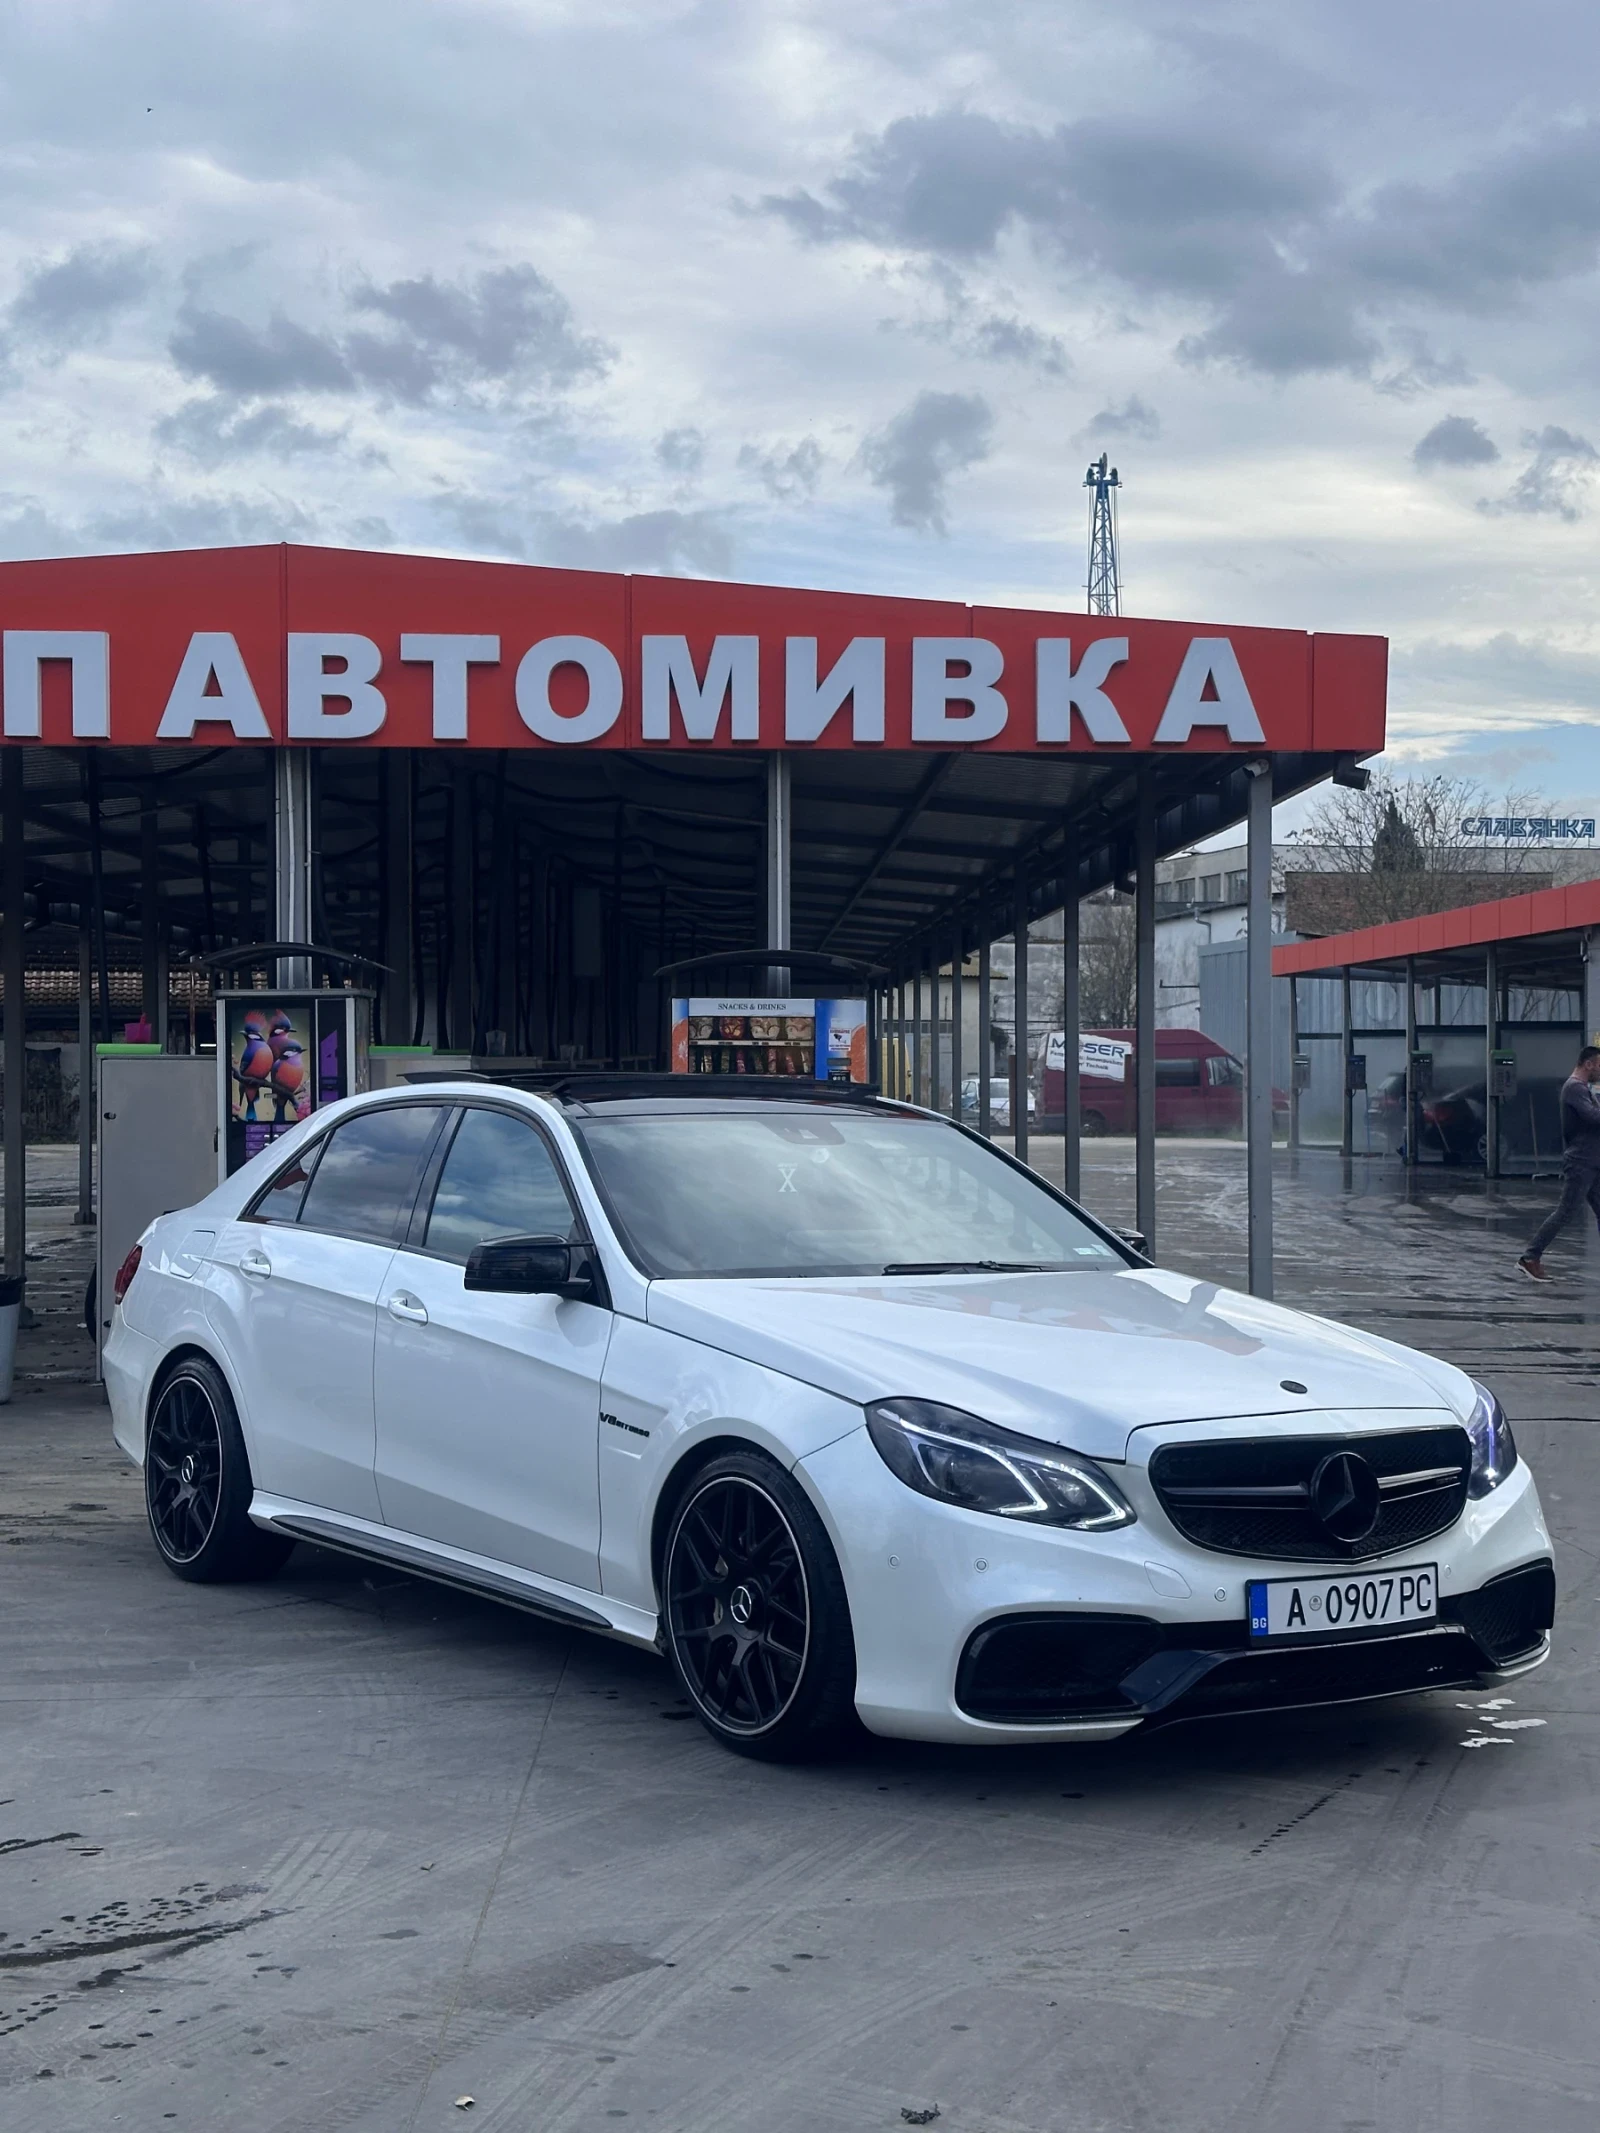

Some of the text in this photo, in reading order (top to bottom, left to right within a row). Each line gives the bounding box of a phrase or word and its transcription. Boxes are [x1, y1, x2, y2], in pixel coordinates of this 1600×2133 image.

[155, 631, 1267, 746] АВТОМИВКА
[1460, 817, 1595, 838] СЛАВЯНКА
[717, 1003, 787, 1011] SNACKS & DRINKS
[1051, 1038, 1125, 1058] MSER
[1252, 1617, 1267, 1629] BG
